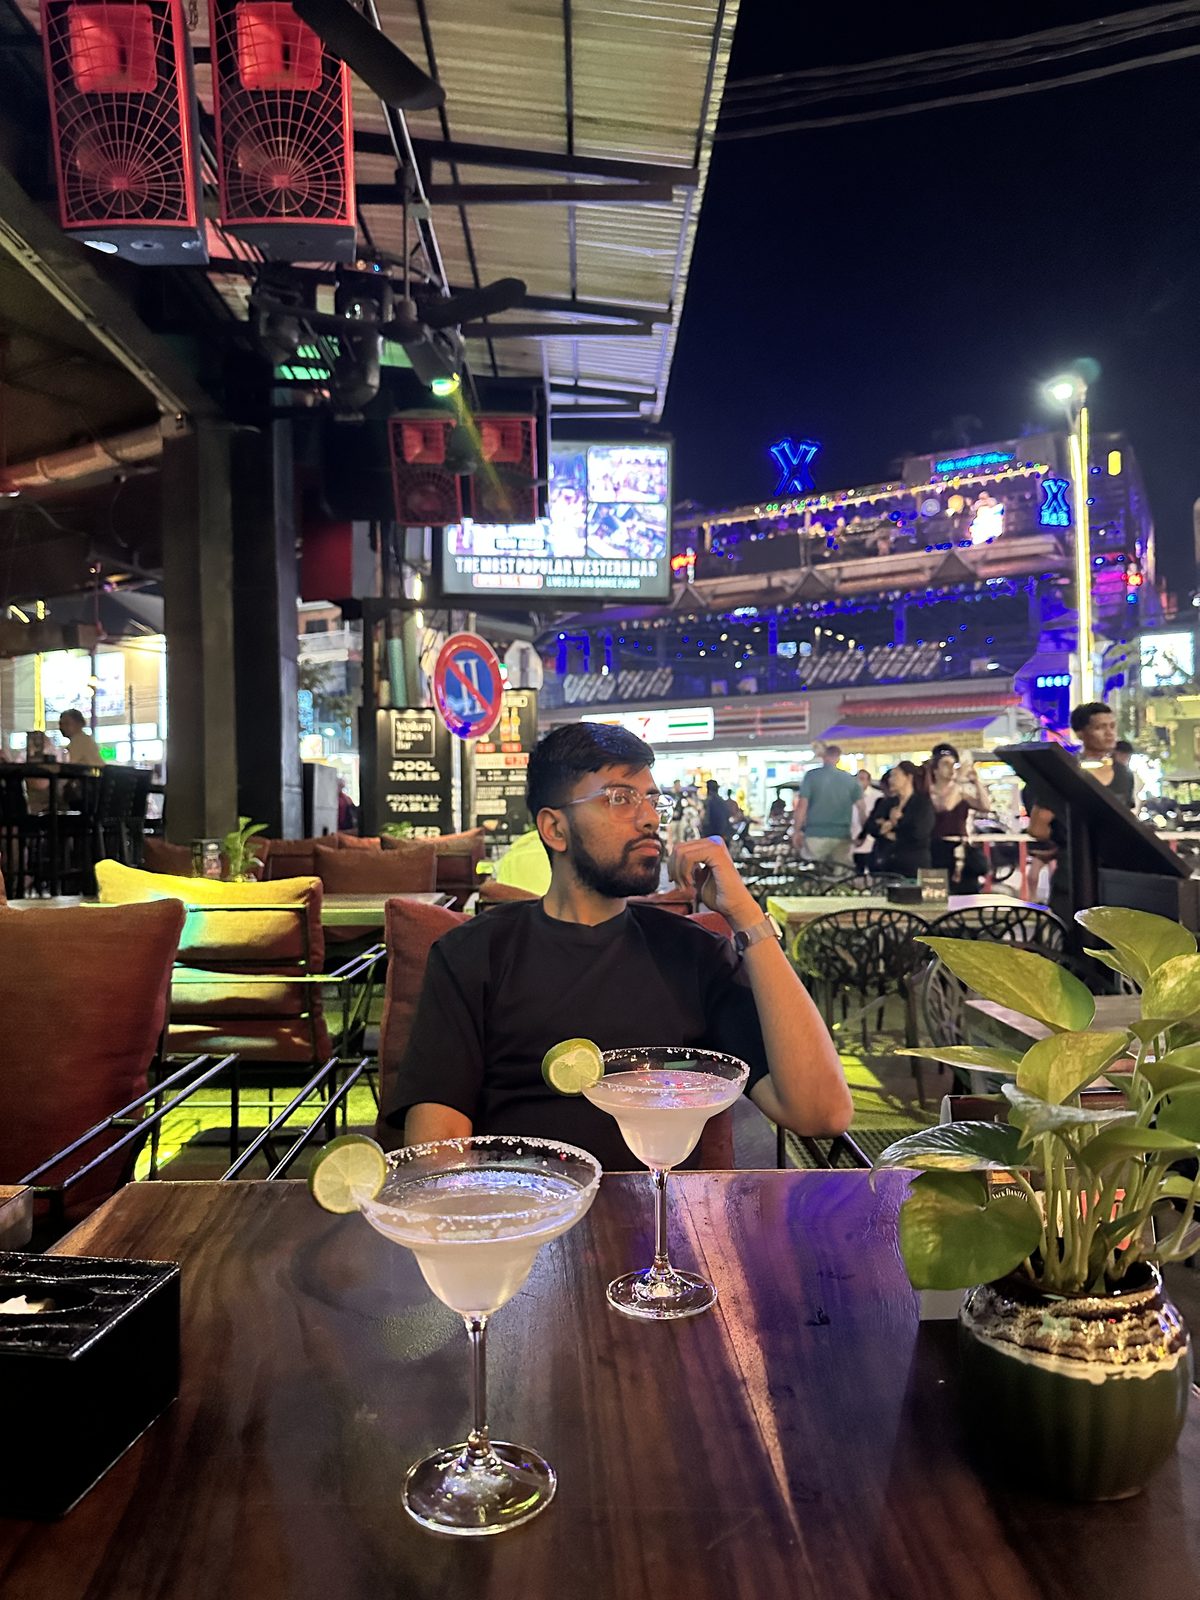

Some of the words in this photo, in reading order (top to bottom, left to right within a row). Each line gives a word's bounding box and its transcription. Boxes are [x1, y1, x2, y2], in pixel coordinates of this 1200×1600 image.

[1041, 479, 1070, 511] X
[455, 556, 479, 573] THE
[480, 557, 515, 574] MOST
[516, 558, 572, 575] POPULAR
[573, 559, 630, 576] WESTERN
[631, 560, 658, 577] BAR
[392, 760, 435, 771] POOL
[388, 771, 440, 781] TABLES
[389, 801, 439, 812] TABLE
